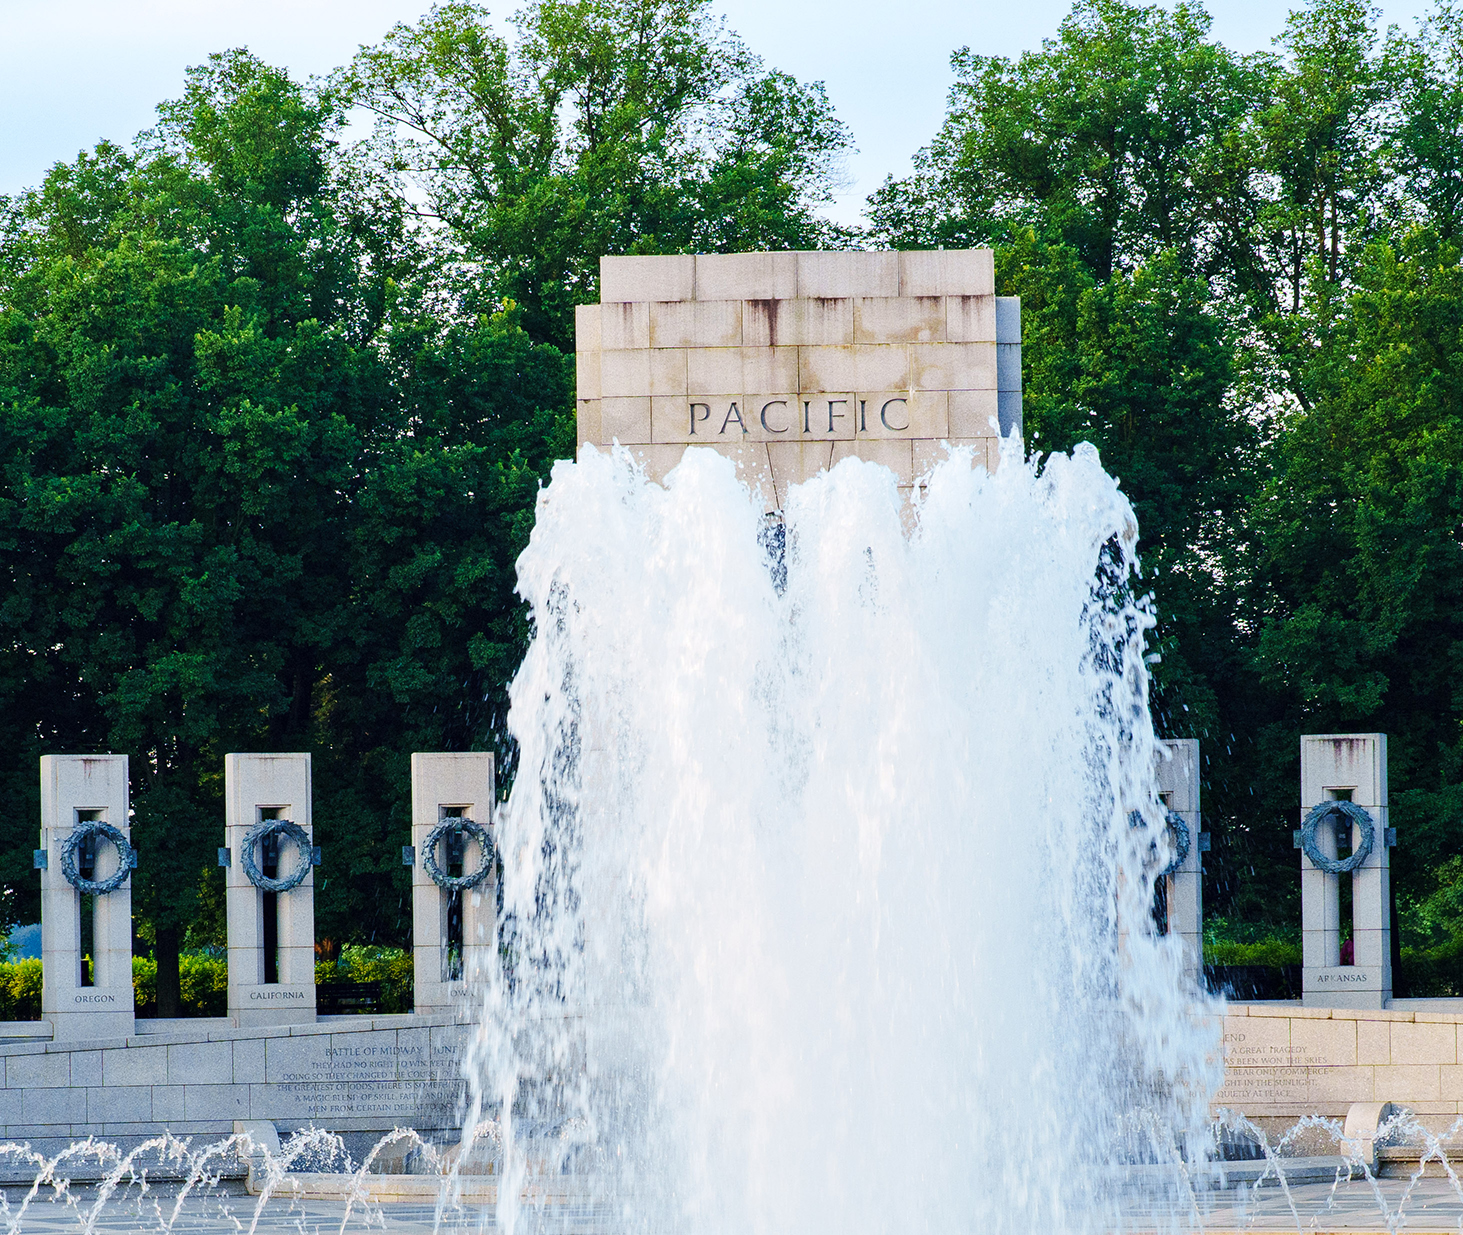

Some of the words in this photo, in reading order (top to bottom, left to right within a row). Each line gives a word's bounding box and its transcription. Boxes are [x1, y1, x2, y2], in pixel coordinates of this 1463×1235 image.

[688, 398, 910, 435] PACIFIC
[1317, 974, 1367, 983] ARKANSAS
[74, 994, 115, 1004] OREGON
[249, 991, 305, 1000] CALIFORNIA
[1224, 1033, 1246, 1042] END
[325, 1047, 361, 1056] BATTLE
[363, 1046, 377, 1056] OF
[380, 1046, 423, 1056] MIDWAY
[1267, 1046, 1307, 1054] TRAGEDY
[333, 1061, 352, 1069] HAD
[354, 1061, 368, 1069] NO
[369, 1060, 394, 1068] RIGHT
[1237, 1057, 1259, 1065] BEEN
[1286, 1056, 1302, 1064] THE
[1304, 1056, 1328, 1064] SKIES
[282, 1073, 310, 1081] DOING
[325, 1072, 346, 1080] THEY
[346, 1071, 388, 1079] CHANGED
[1255, 1068, 1278, 1076] ONLY
[294, 1083, 335, 1091] GREATEST
[336, 1083, 348, 1091] OF
[376, 1082, 403, 1090] THERE
[1244, 1079, 1254, 1087] IN
[1255, 1079, 1273, 1087] THE
[303, 1094, 331, 1102] MAGIC
[1217, 1090, 1251, 1098] QUIETLY
[1252, 1090, 1263, 1098] AT
[308, 1105, 327, 1113] MEN
[356, 1103, 391, 1112] CERTAIN
